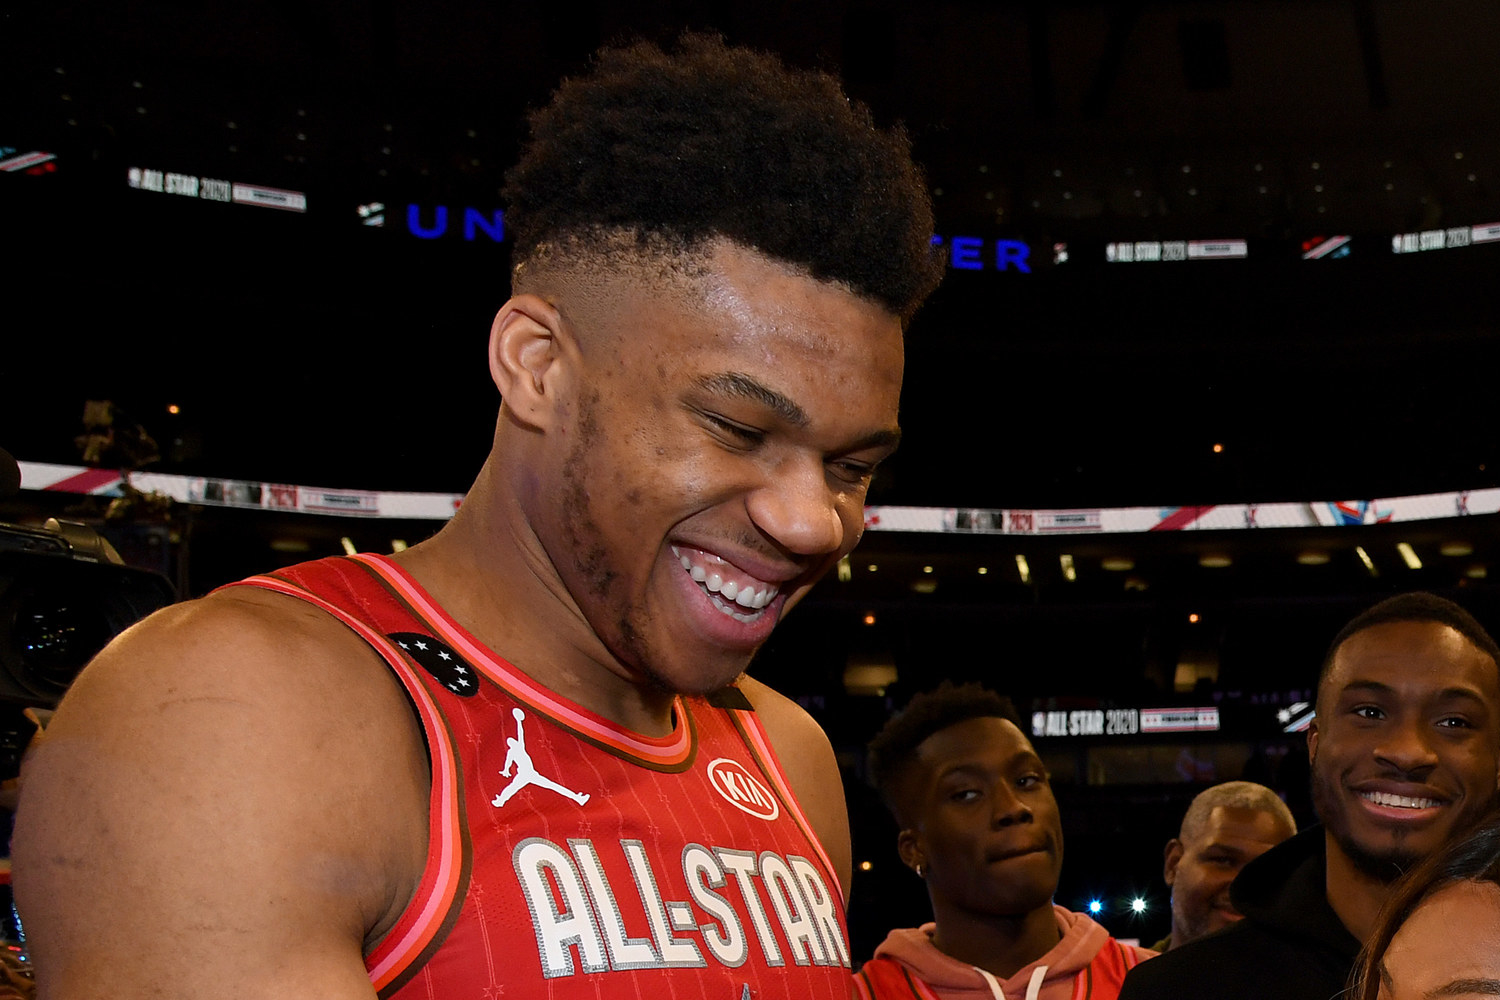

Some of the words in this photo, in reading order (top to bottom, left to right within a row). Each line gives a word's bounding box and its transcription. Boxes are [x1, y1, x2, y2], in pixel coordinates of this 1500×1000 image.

[930, 234, 1032, 274] ER
[1105, 708, 1139, 735] 2020
[715, 769, 773, 810] KIA
[512, 837, 852, 979] ALL-STAR
